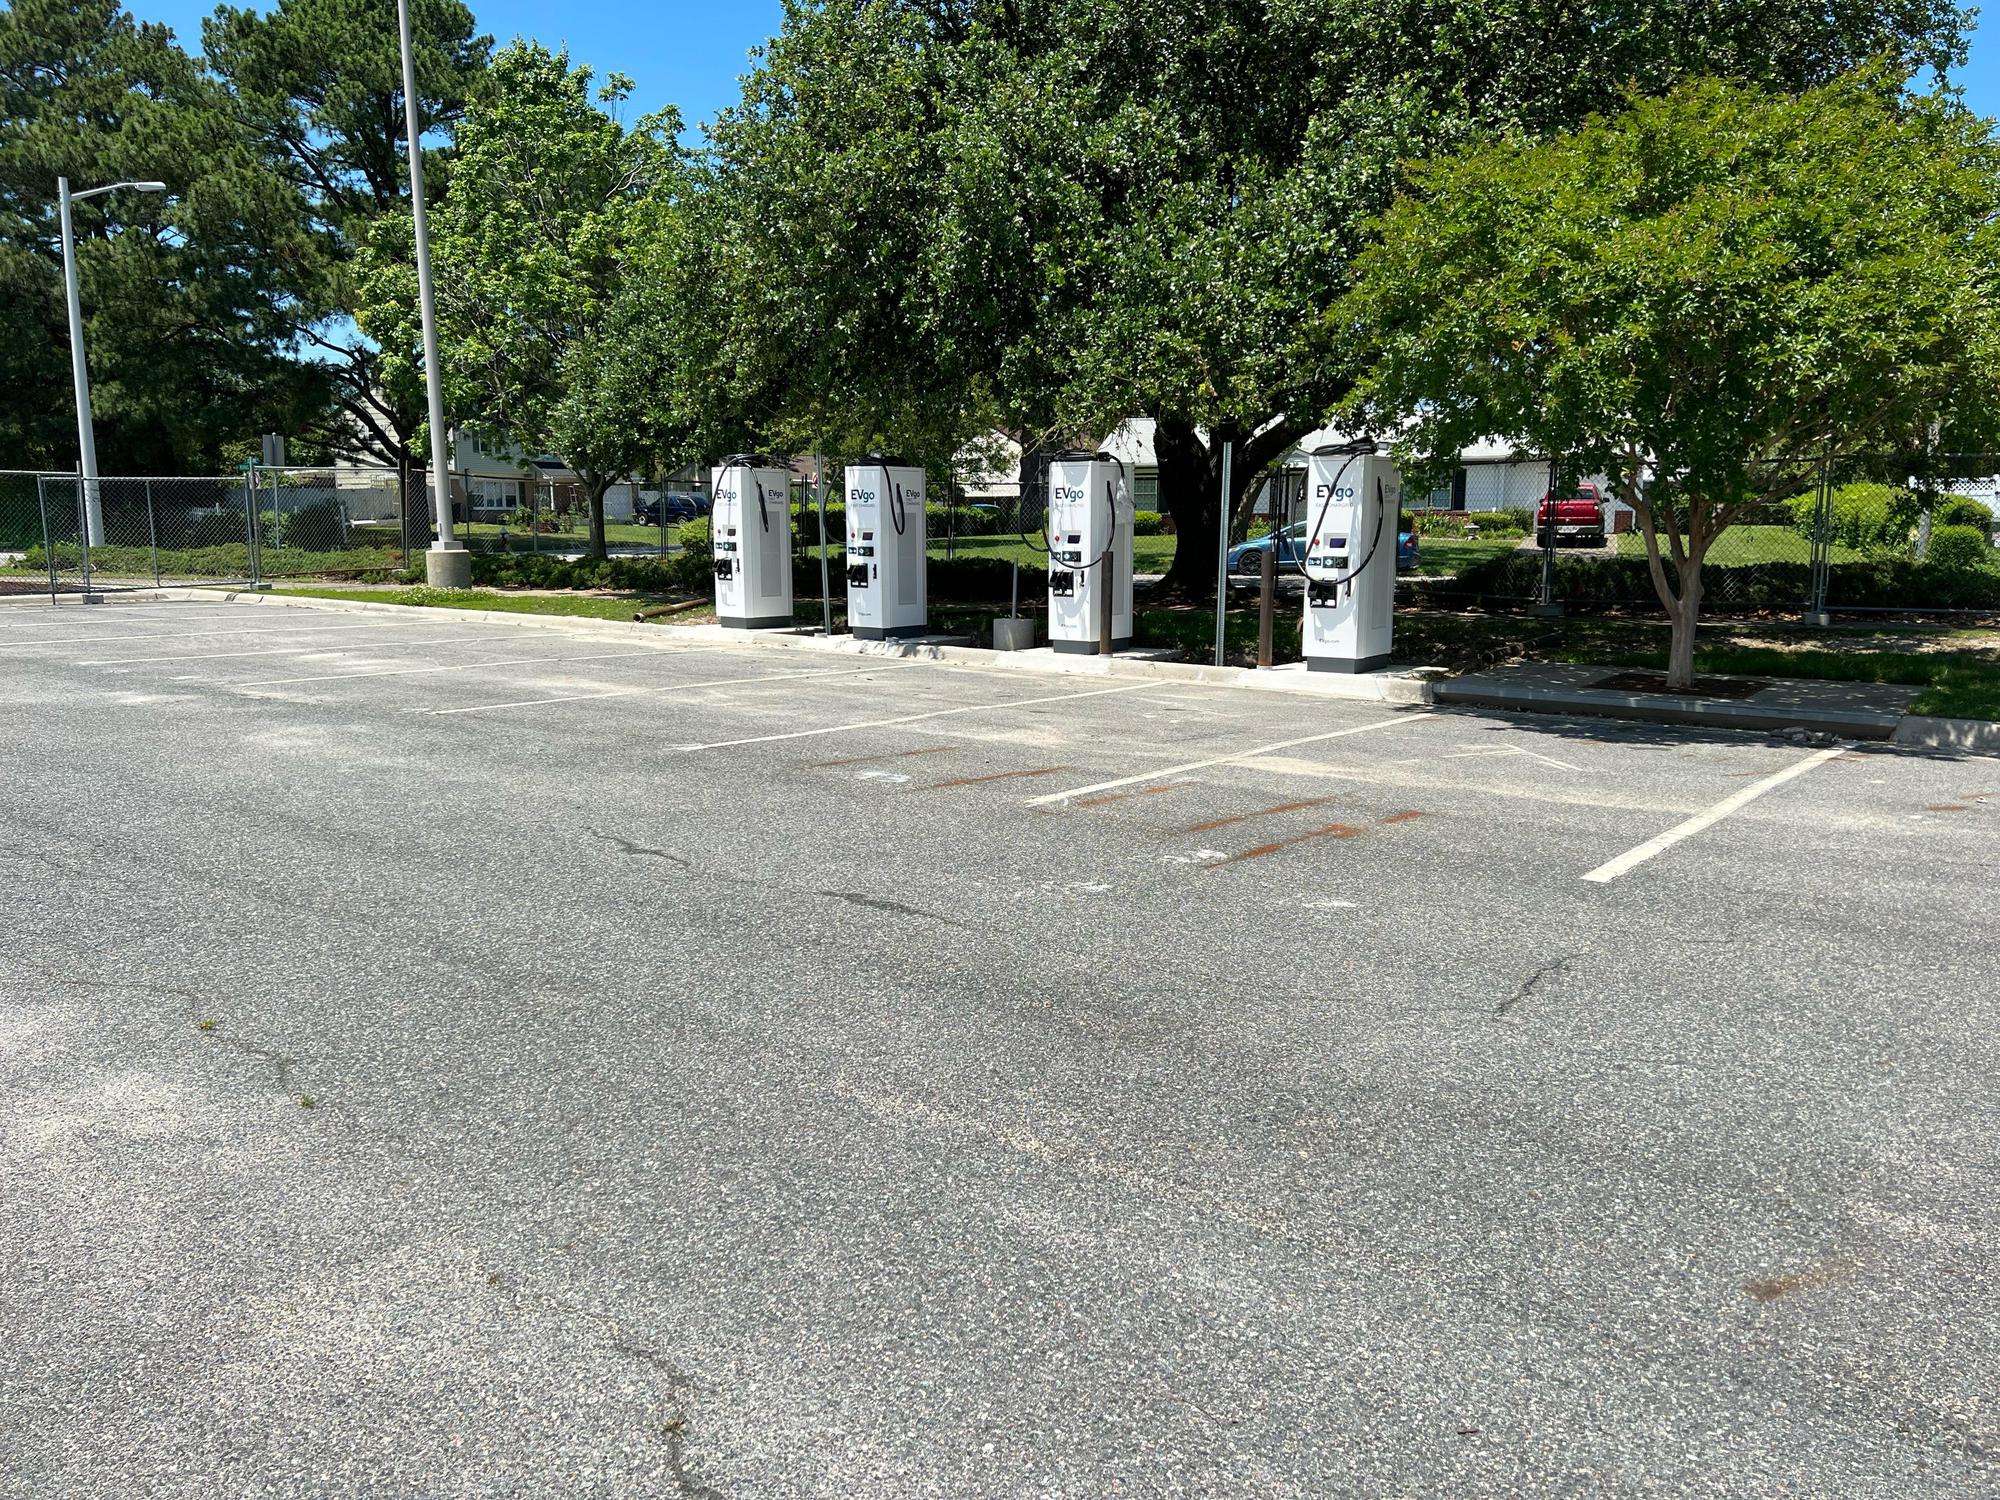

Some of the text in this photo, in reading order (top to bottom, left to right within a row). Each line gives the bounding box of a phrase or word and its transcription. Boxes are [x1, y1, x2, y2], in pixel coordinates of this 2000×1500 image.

[717, 489, 737, 502] EVgo
[768, 489, 784, 499] EVgo
[851, 489, 875, 503] EVgo
[906, 489, 920, 499] EVgo
[1055, 488, 1084, 502] EVgo
